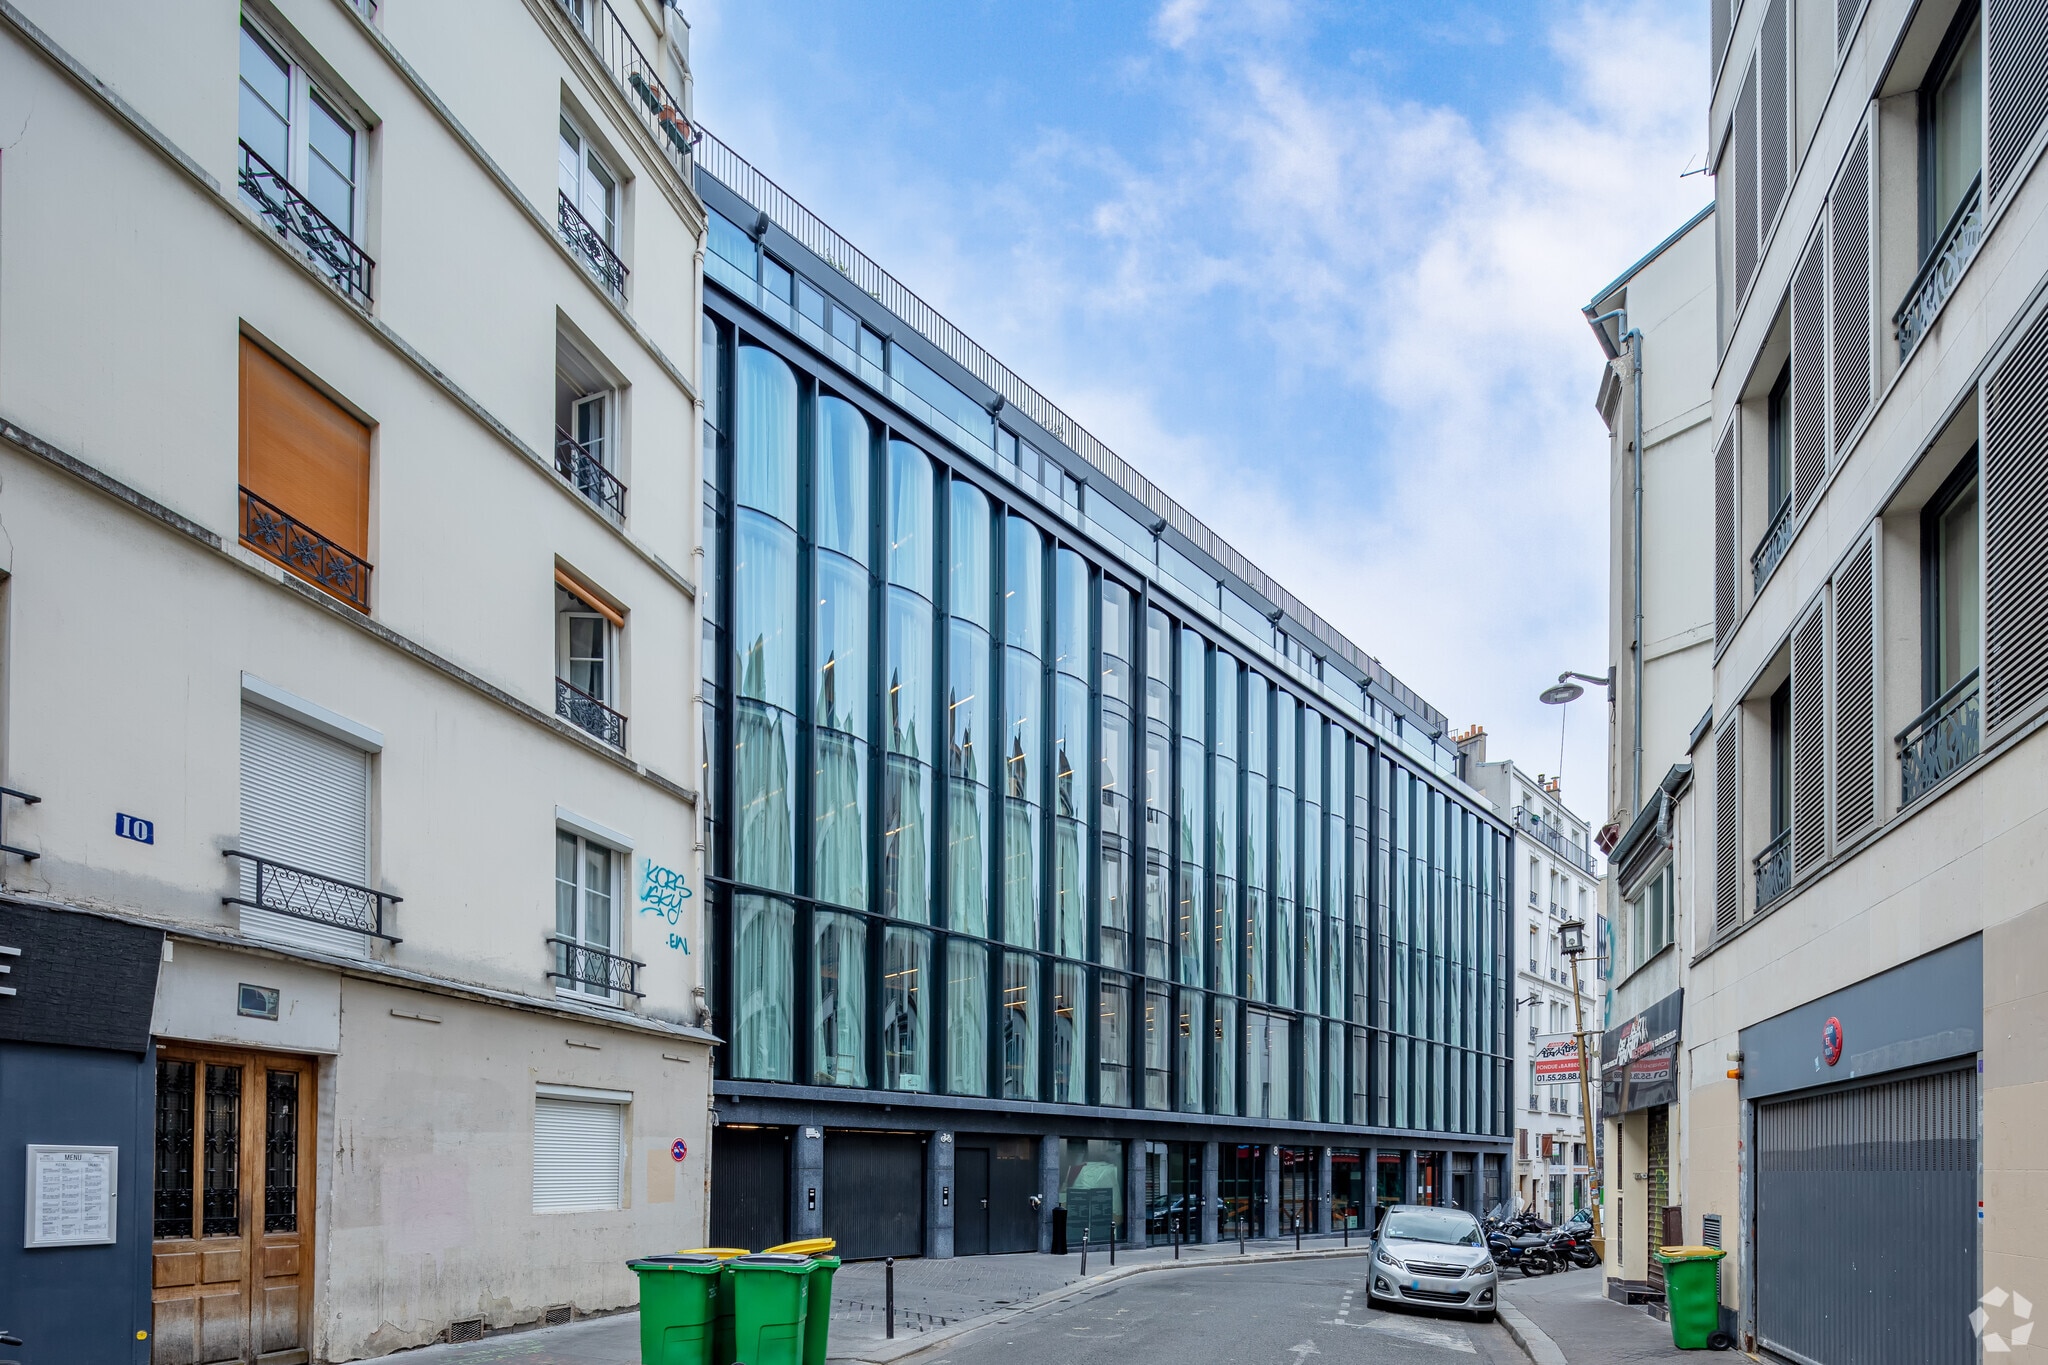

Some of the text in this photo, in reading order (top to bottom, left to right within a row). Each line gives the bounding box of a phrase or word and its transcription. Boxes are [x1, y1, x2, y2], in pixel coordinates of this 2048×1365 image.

[122, 816, 148, 840] 10
[1273, 1145, 1279, 1156] 8
[1326, 1147, 1331, 1157] 6
